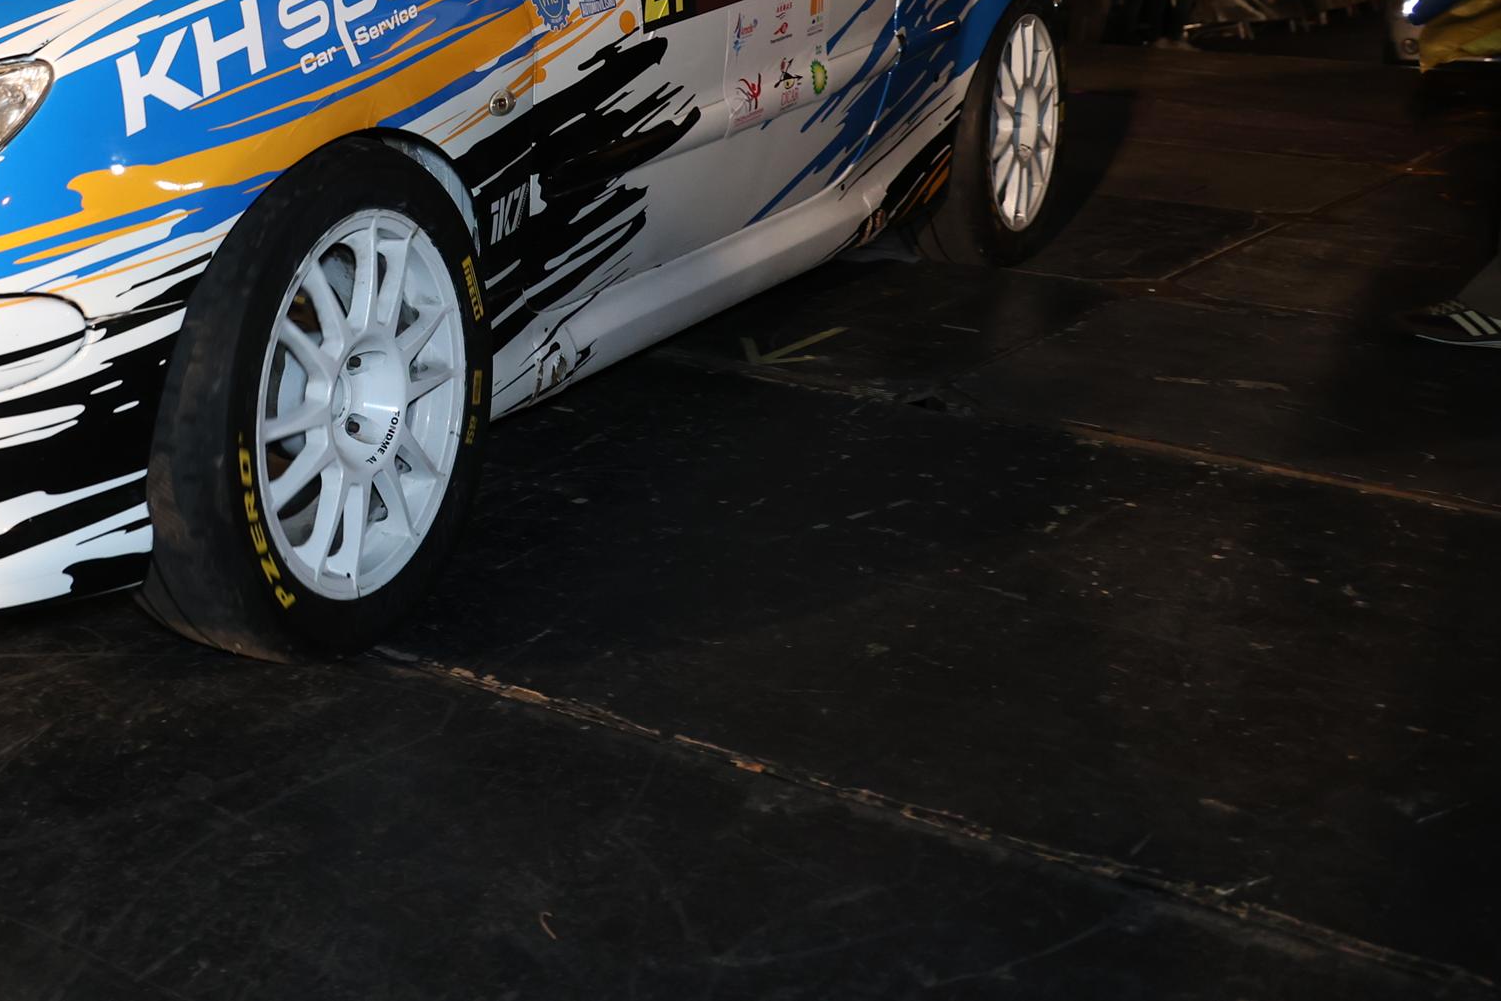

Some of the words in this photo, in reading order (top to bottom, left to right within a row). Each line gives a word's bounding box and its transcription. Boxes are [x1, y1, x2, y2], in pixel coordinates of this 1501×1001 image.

[300, 46, 337, 74] Car
[354, 4, 418, 46] Service
[460, 253, 485, 323] PIRELLI
[365, 410, 400, 465] FONDMEAL
